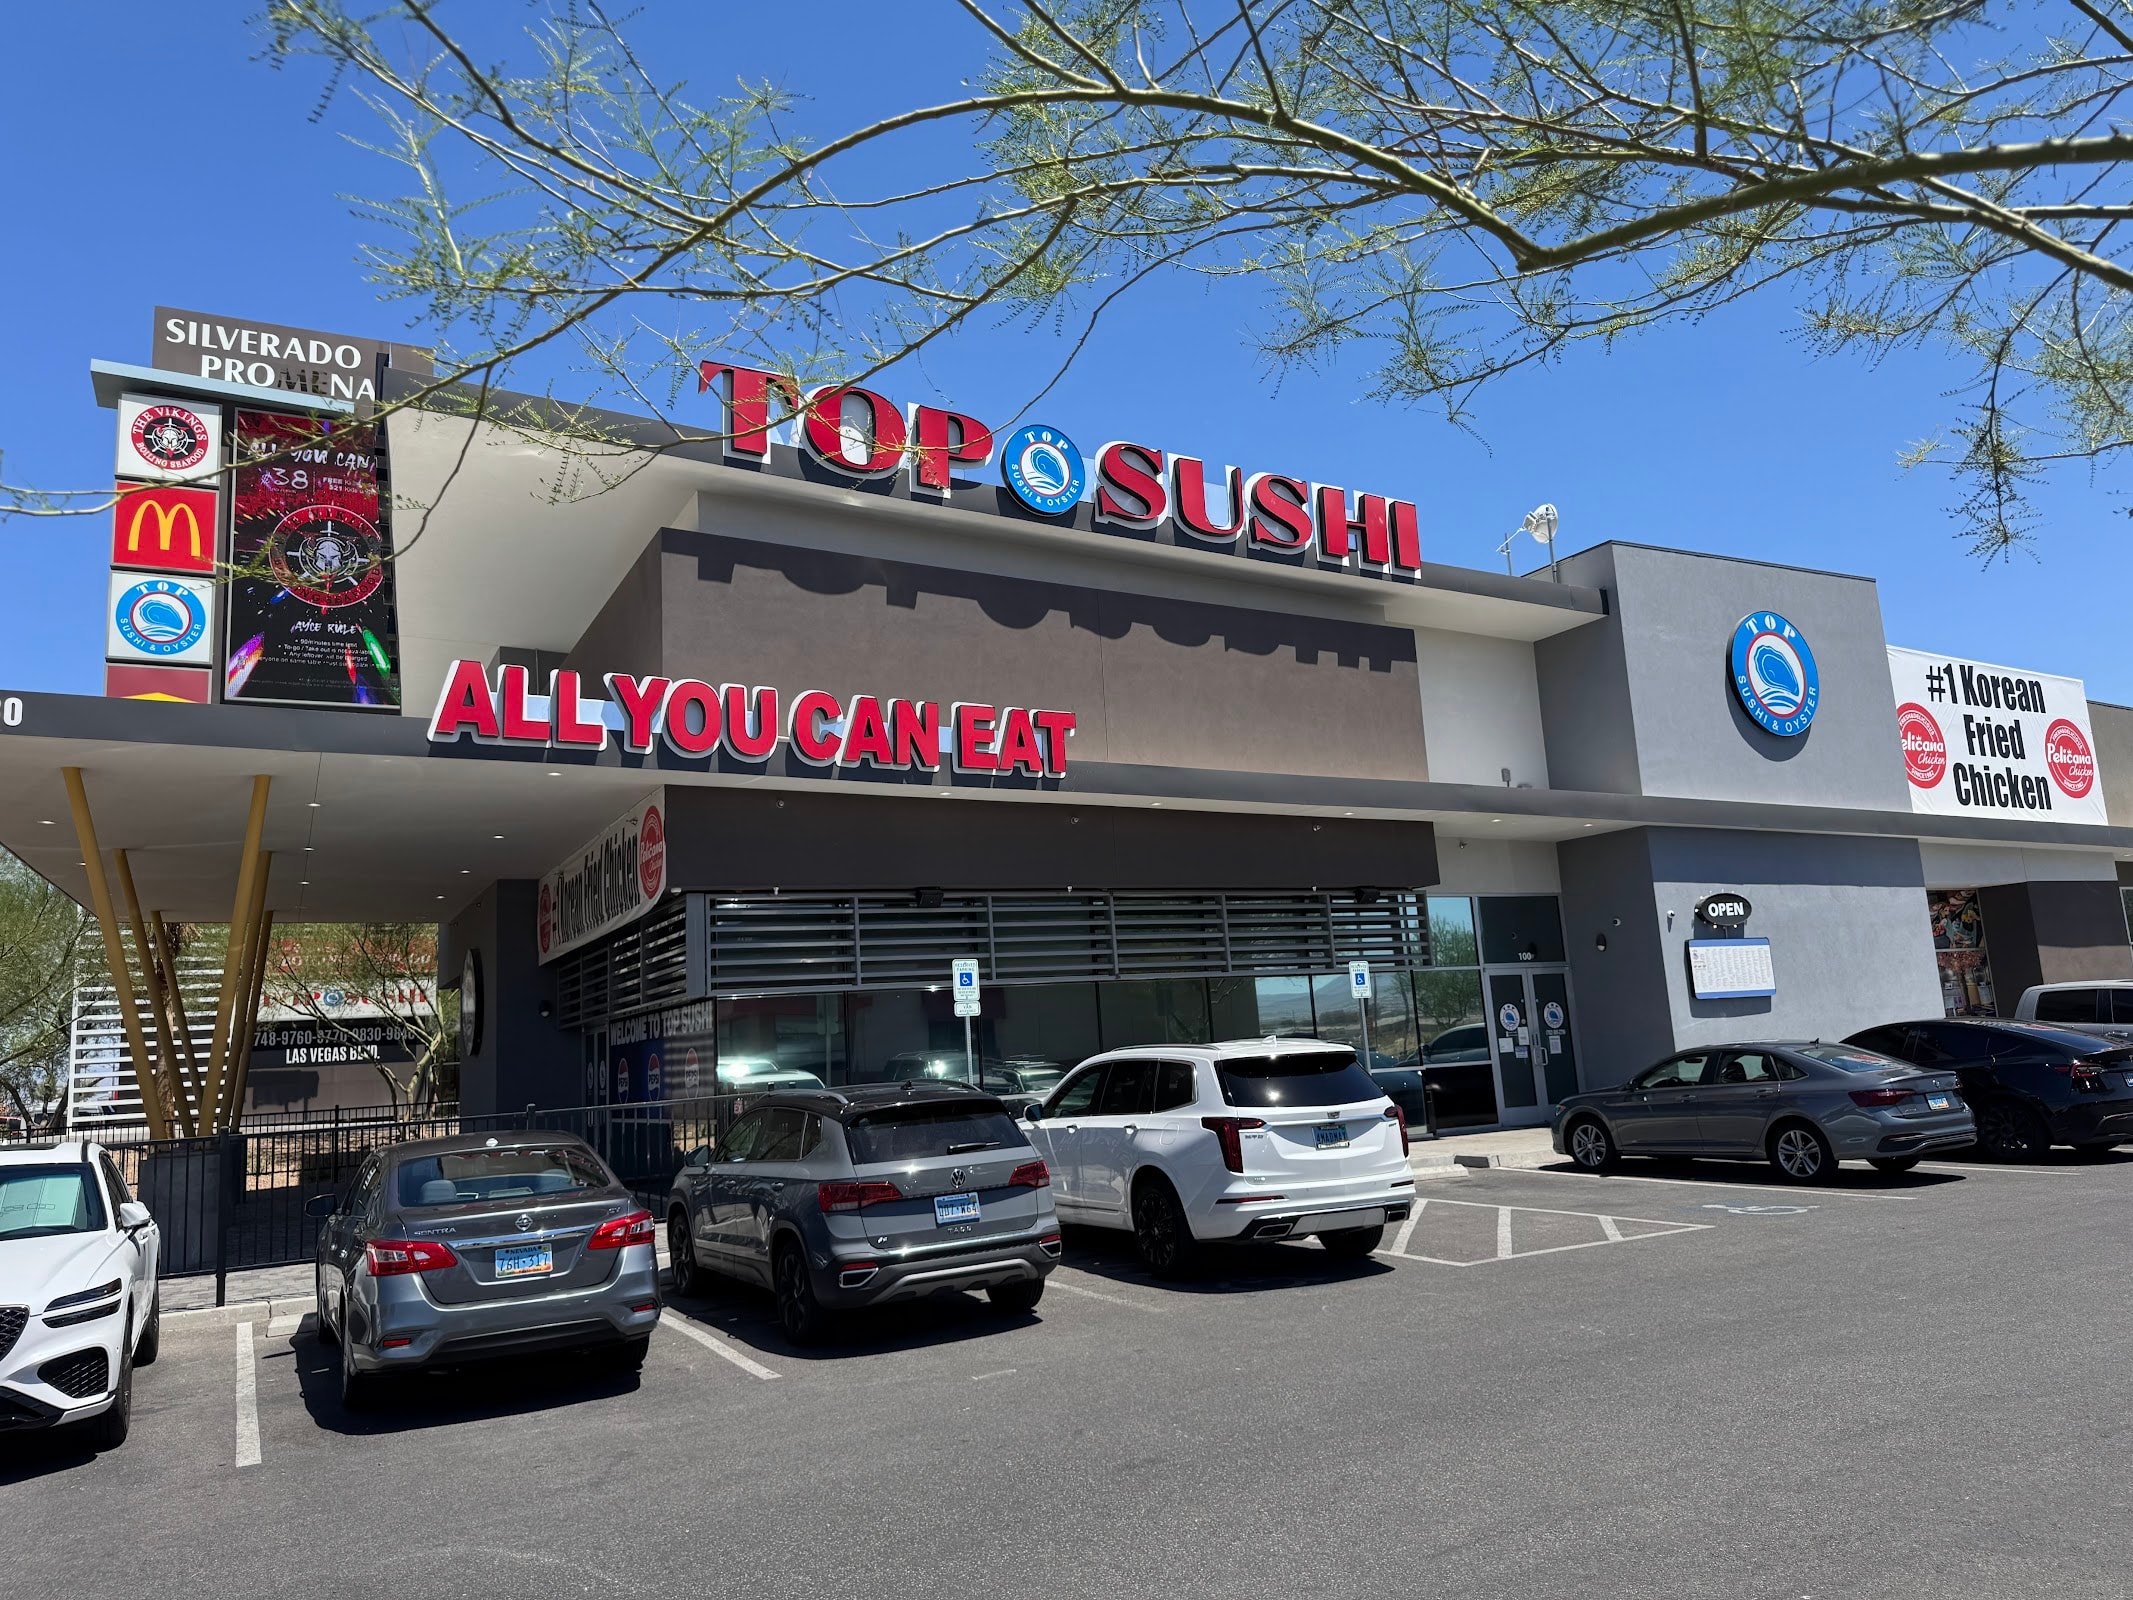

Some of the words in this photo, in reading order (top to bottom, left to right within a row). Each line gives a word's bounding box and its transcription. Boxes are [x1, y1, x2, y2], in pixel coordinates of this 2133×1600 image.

[166, 318, 361, 369] SILVERADO
[132, 412, 153, 435] THE
[154, 407, 208, 441] VIKINGS
[1024, 431, 1069, 449] TOP
[135, 442, 168, 467] BOILING
[169, 448, 205, 469] SEAFOOD
[698, 360, 994, 497] TOP
[1096, 441, 1421, 576] SUSHI
[1012, 463, 1033, 498] SUSHI
[1035, 496, 1042, 504] &
[1046, 479, 1080, 507] OYSTER
[136, 582, 189, 597] TOP
[120, 617, 146, 647] SUSHI
[149, 644, 156, 652] &
[162, 623, 202, 652] OYSTER
[1745, 614, 1797, 639] TOP
[1738, 675, 1768, 724] SUSHI
[1772, 720, 1779, 731] &
[1785, 686, 1817, 733] OYSTER
[1925, 663, 1958, 704] #1
[1958, 664, 2047, 714] Korean
[428, 660, 607, 750] ALL
[604, 673, 778, 763] YOU
[790, 690, 940, 772] CAN
[952, 702, 1076, 778] EAT
[1901, 731, 1944, 753] elicana
[1963, 714, 2026, 760] Fried
[1917, 751, 1946, 765] Chicken
[1952, 762, 2053, 811] Chicken
[1707, 902, 1745, 917] OPEN
[1518, 952, 1532, 961] 100
[610, 1016, 648, 1047] WELCOME
[648, 1013, 661, 1040] TO
[662, 1007, 682, 1038] TOP
[682, 1000, 713, 1034] SUSHI
[286, 1048, 308, 1065] LAS
[311, 1046, 348, 1063] VEGAS
[413, 1227, 457, 1236] SENTRA
